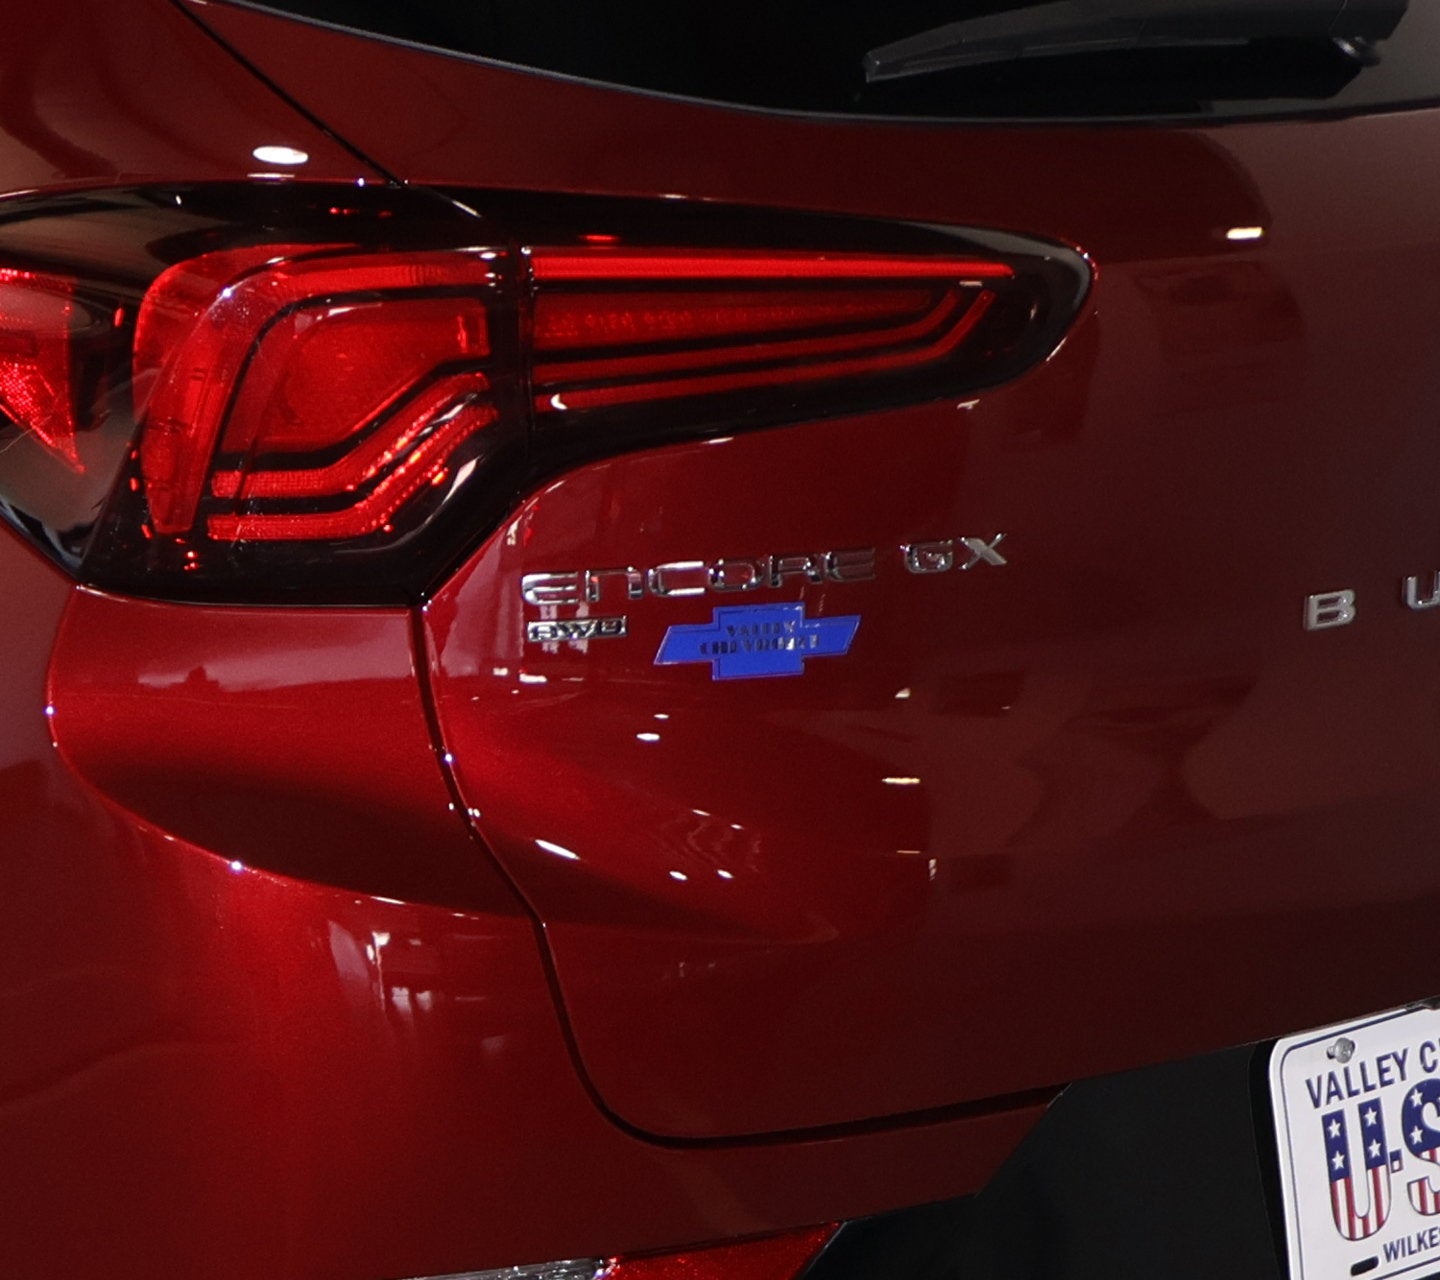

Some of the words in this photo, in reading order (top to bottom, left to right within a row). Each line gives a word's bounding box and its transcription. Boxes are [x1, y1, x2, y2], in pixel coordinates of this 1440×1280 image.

[521, 548, 877, 604] ENCORE
[900, 533, 1008, 574] GX
[527, 616, 627, 643] AWD
[1305, 1047, 1409, 1110] VALLEY
